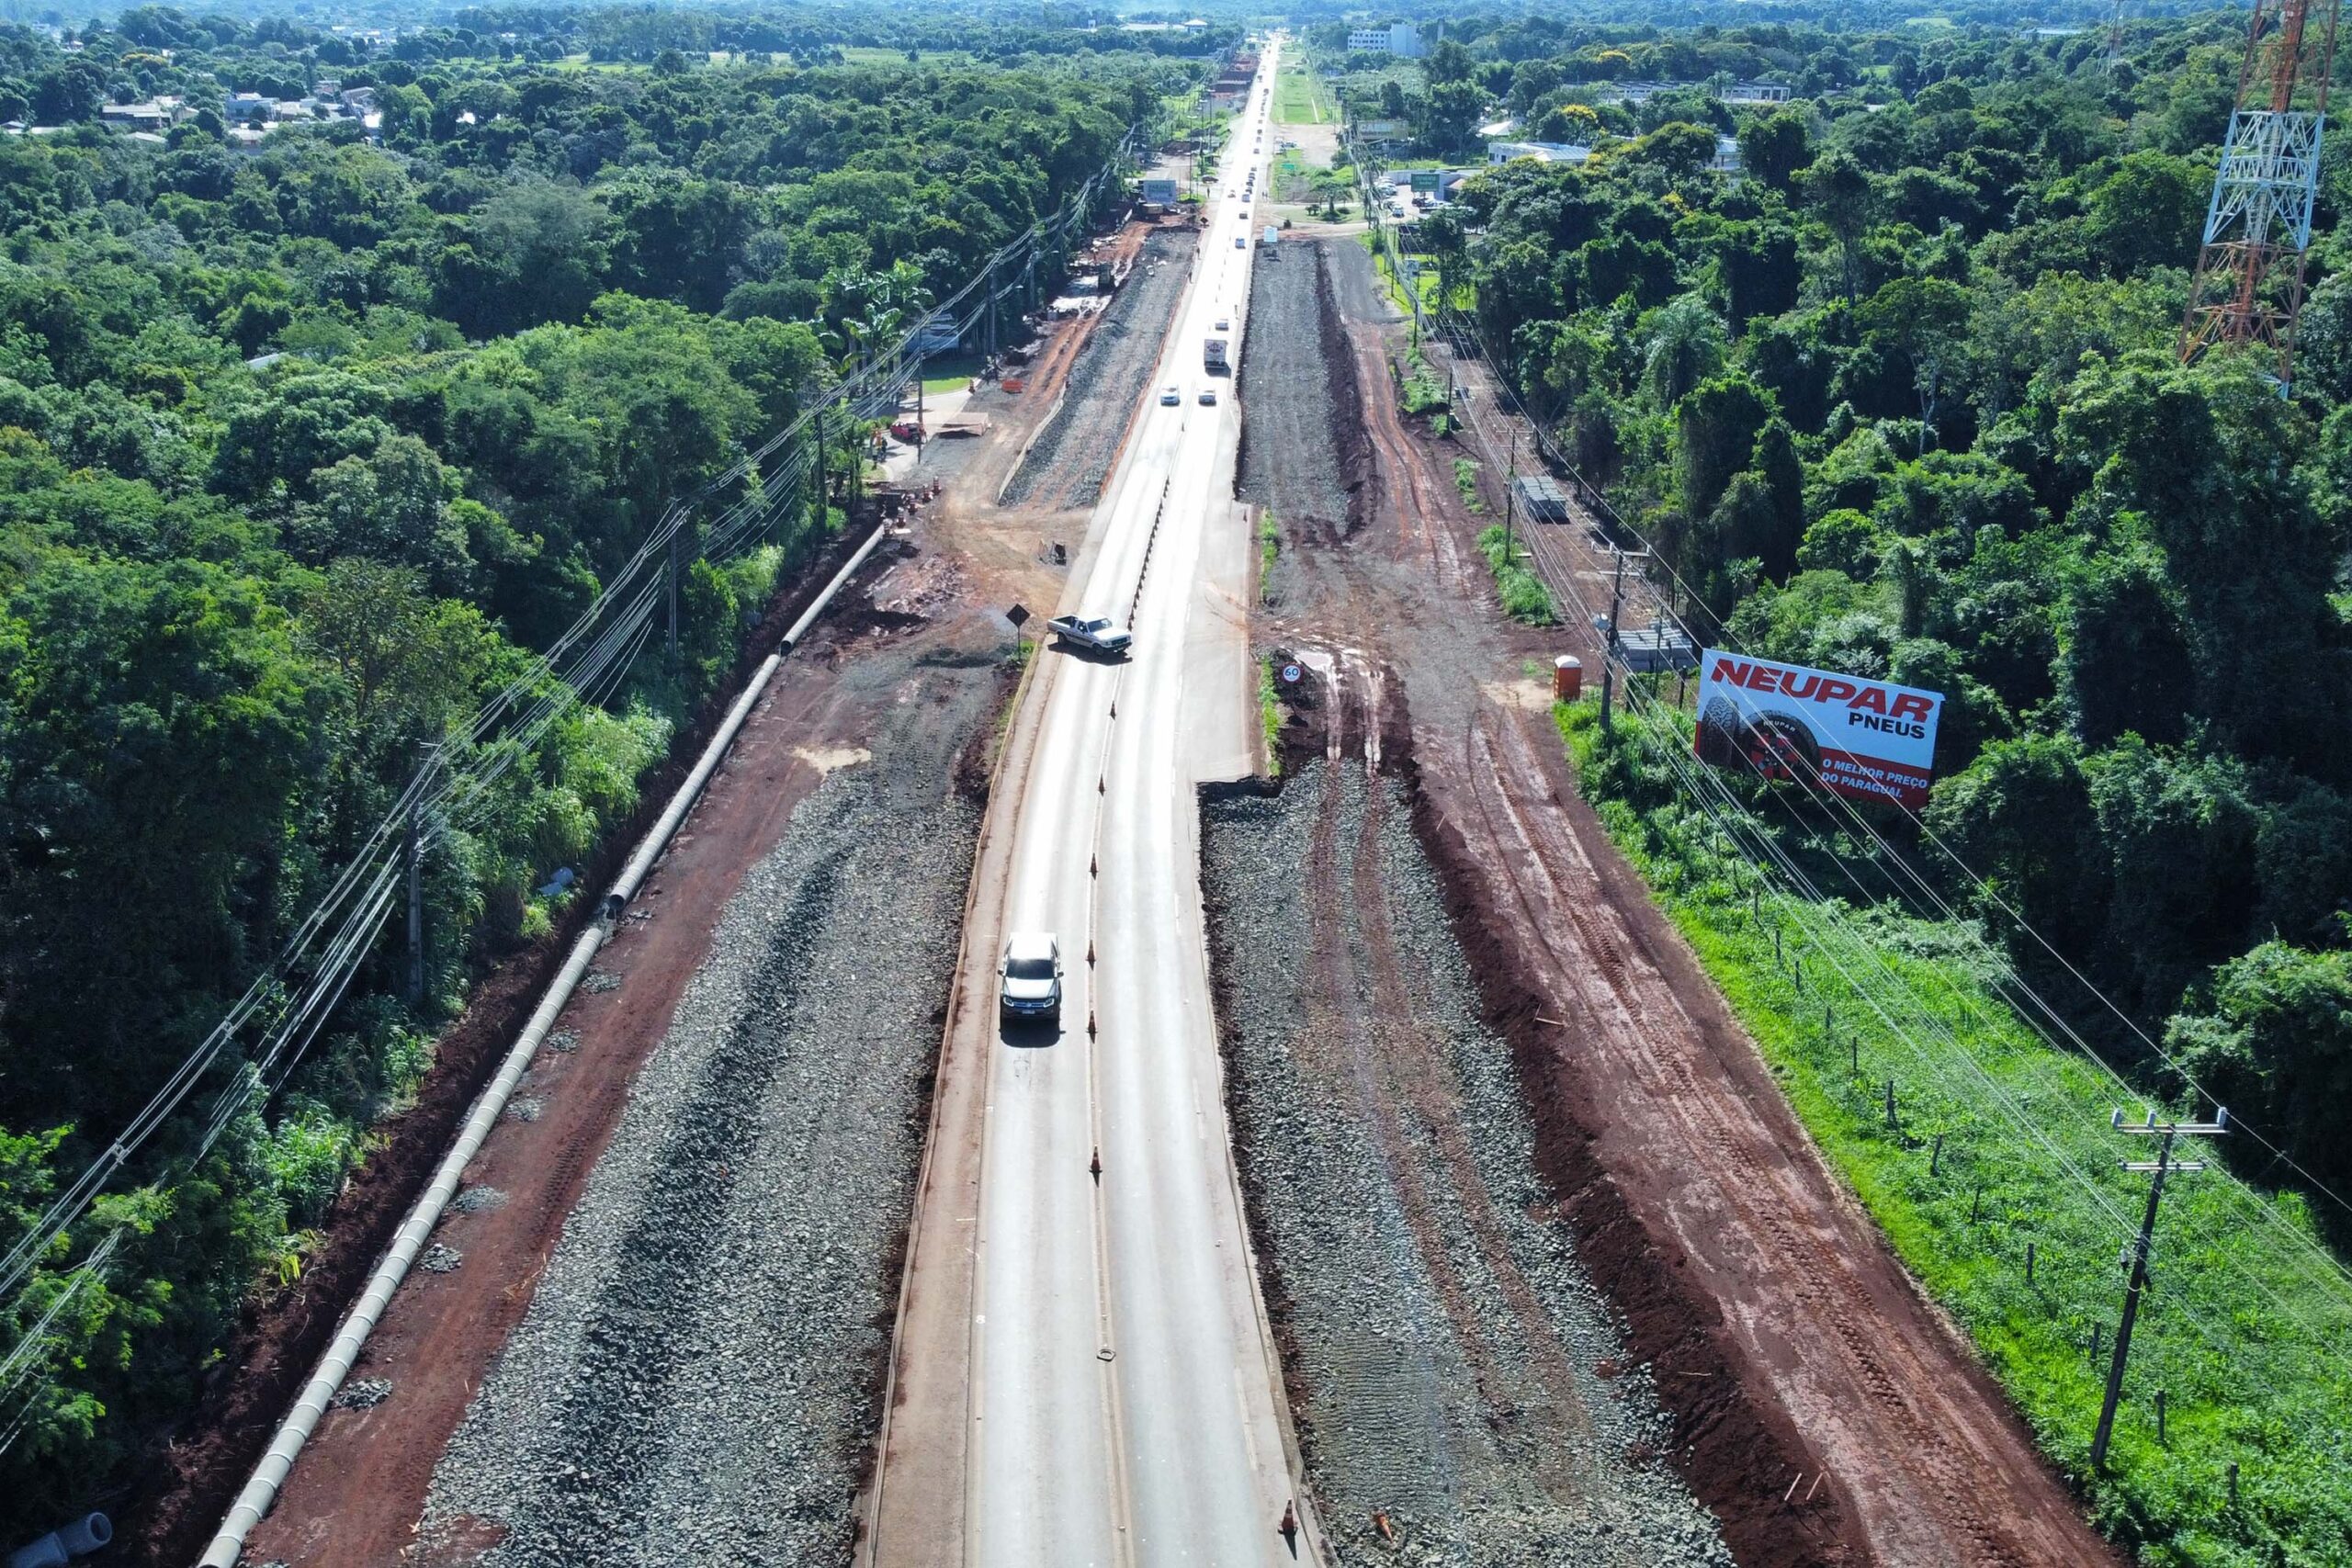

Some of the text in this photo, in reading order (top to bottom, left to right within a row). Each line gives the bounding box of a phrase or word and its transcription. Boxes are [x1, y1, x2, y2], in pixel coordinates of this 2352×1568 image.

[1284, 668, 1298, 676] 60
[1711, 659, 1934, 723] NEUPAR
[1763, 720, 1796, 733] NEUPAR
[1849, 712, 1926, 739] PNEUS
[1821, 772, 1903, 798] DO PARAGUAI.
[1823, 758, 1928, 789] O MELHOR PREÇO
